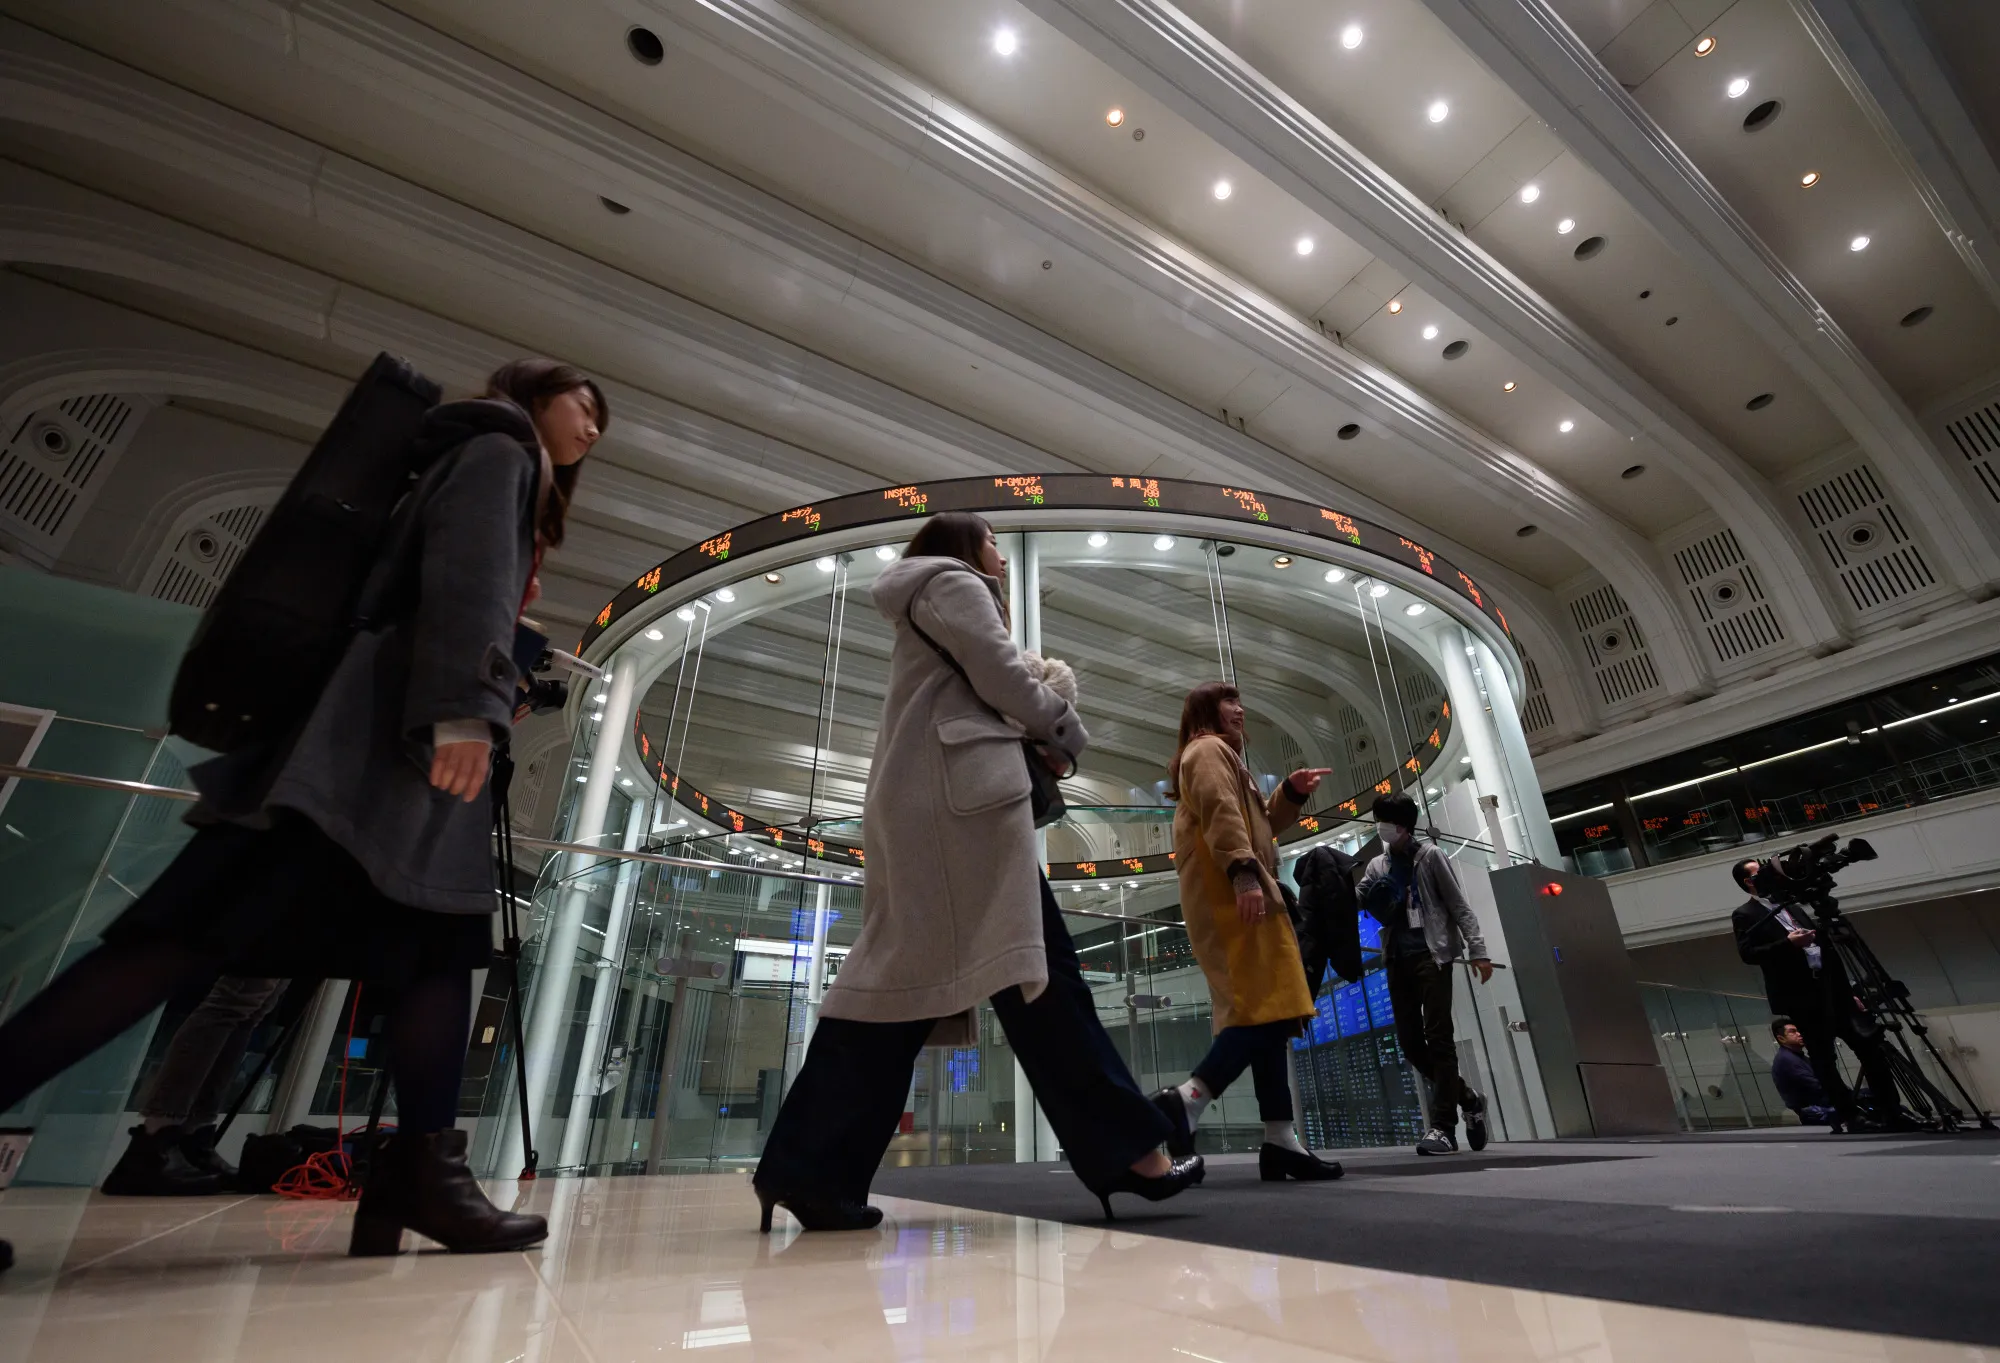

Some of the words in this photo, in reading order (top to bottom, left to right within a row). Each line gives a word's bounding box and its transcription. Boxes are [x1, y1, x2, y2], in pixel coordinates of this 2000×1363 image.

[884, 486, 917, 500] INSPEC
[1013, 485, 1044, 497] 2,495
[898, 493, 928, 507] 1,013
[1025, 494, 1044, 505] -76
[1142, 497, 1160, 508] -31
[909, 503, 926, 514] -71
[804, 512, 821, 525] 123
[808, 521, 820, 532] -7
